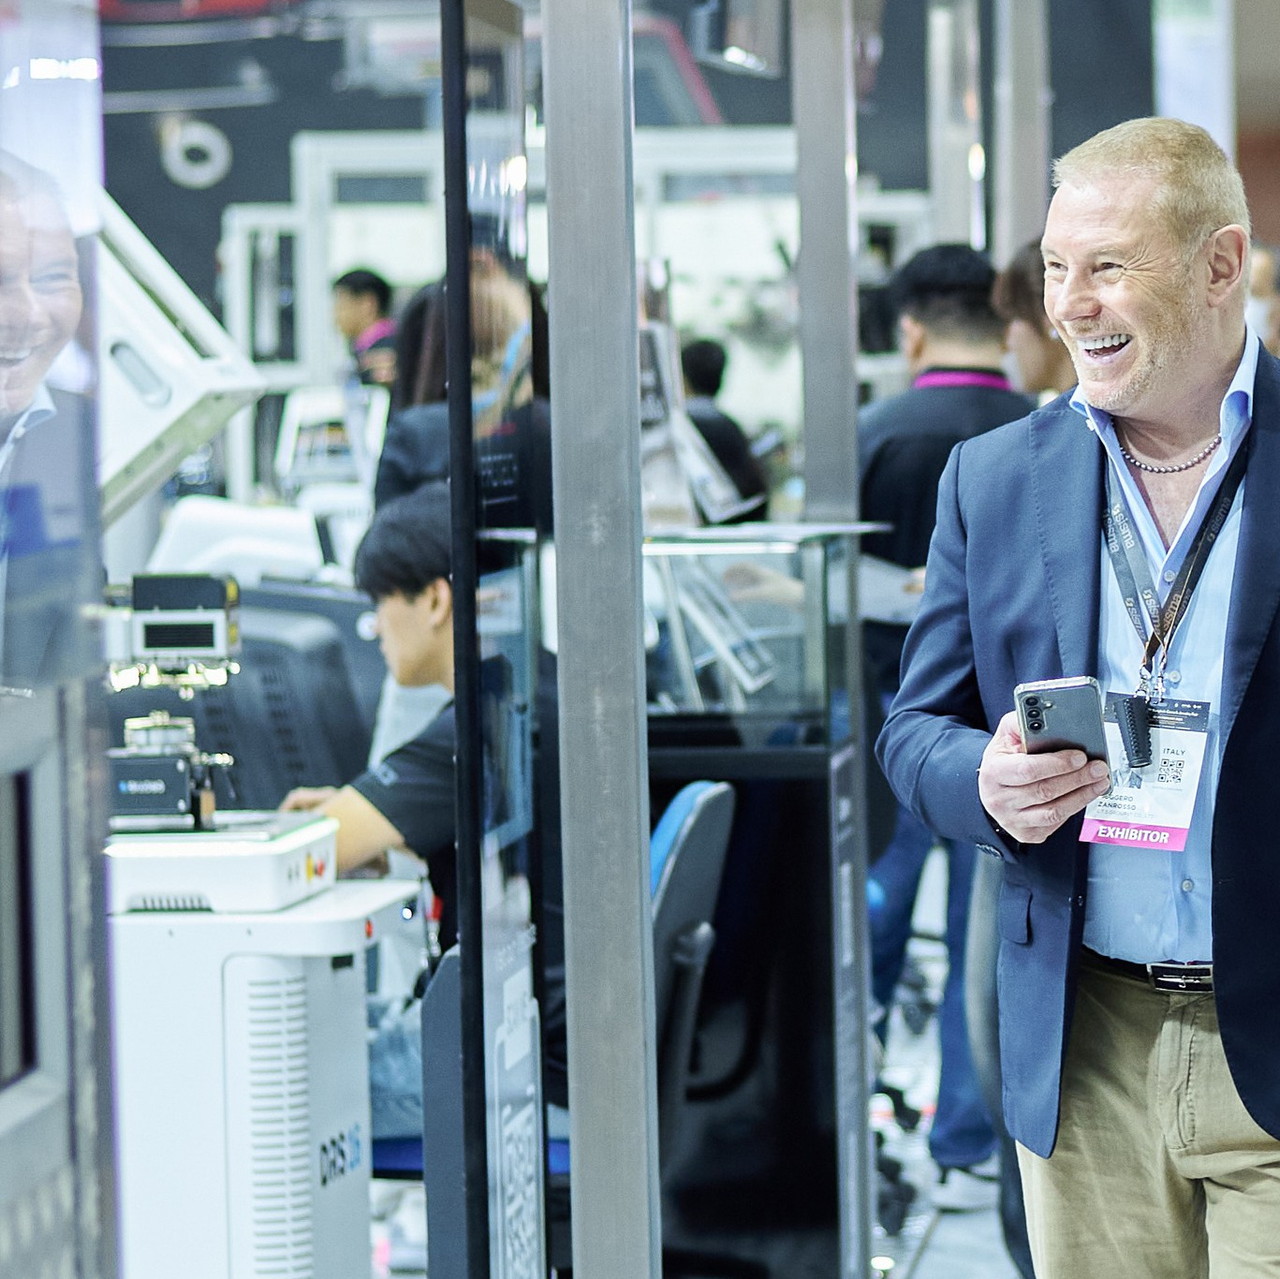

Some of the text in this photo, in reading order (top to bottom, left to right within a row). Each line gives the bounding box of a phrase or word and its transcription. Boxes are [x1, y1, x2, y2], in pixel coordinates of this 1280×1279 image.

[1115, 512, 1135, 550] sisma
[1163, 748, 1186, 756] ITALY
[1097, 801, 1137, 811] ZANROSSO
[1098, 826, 1170, 844] EXHIBITOR
